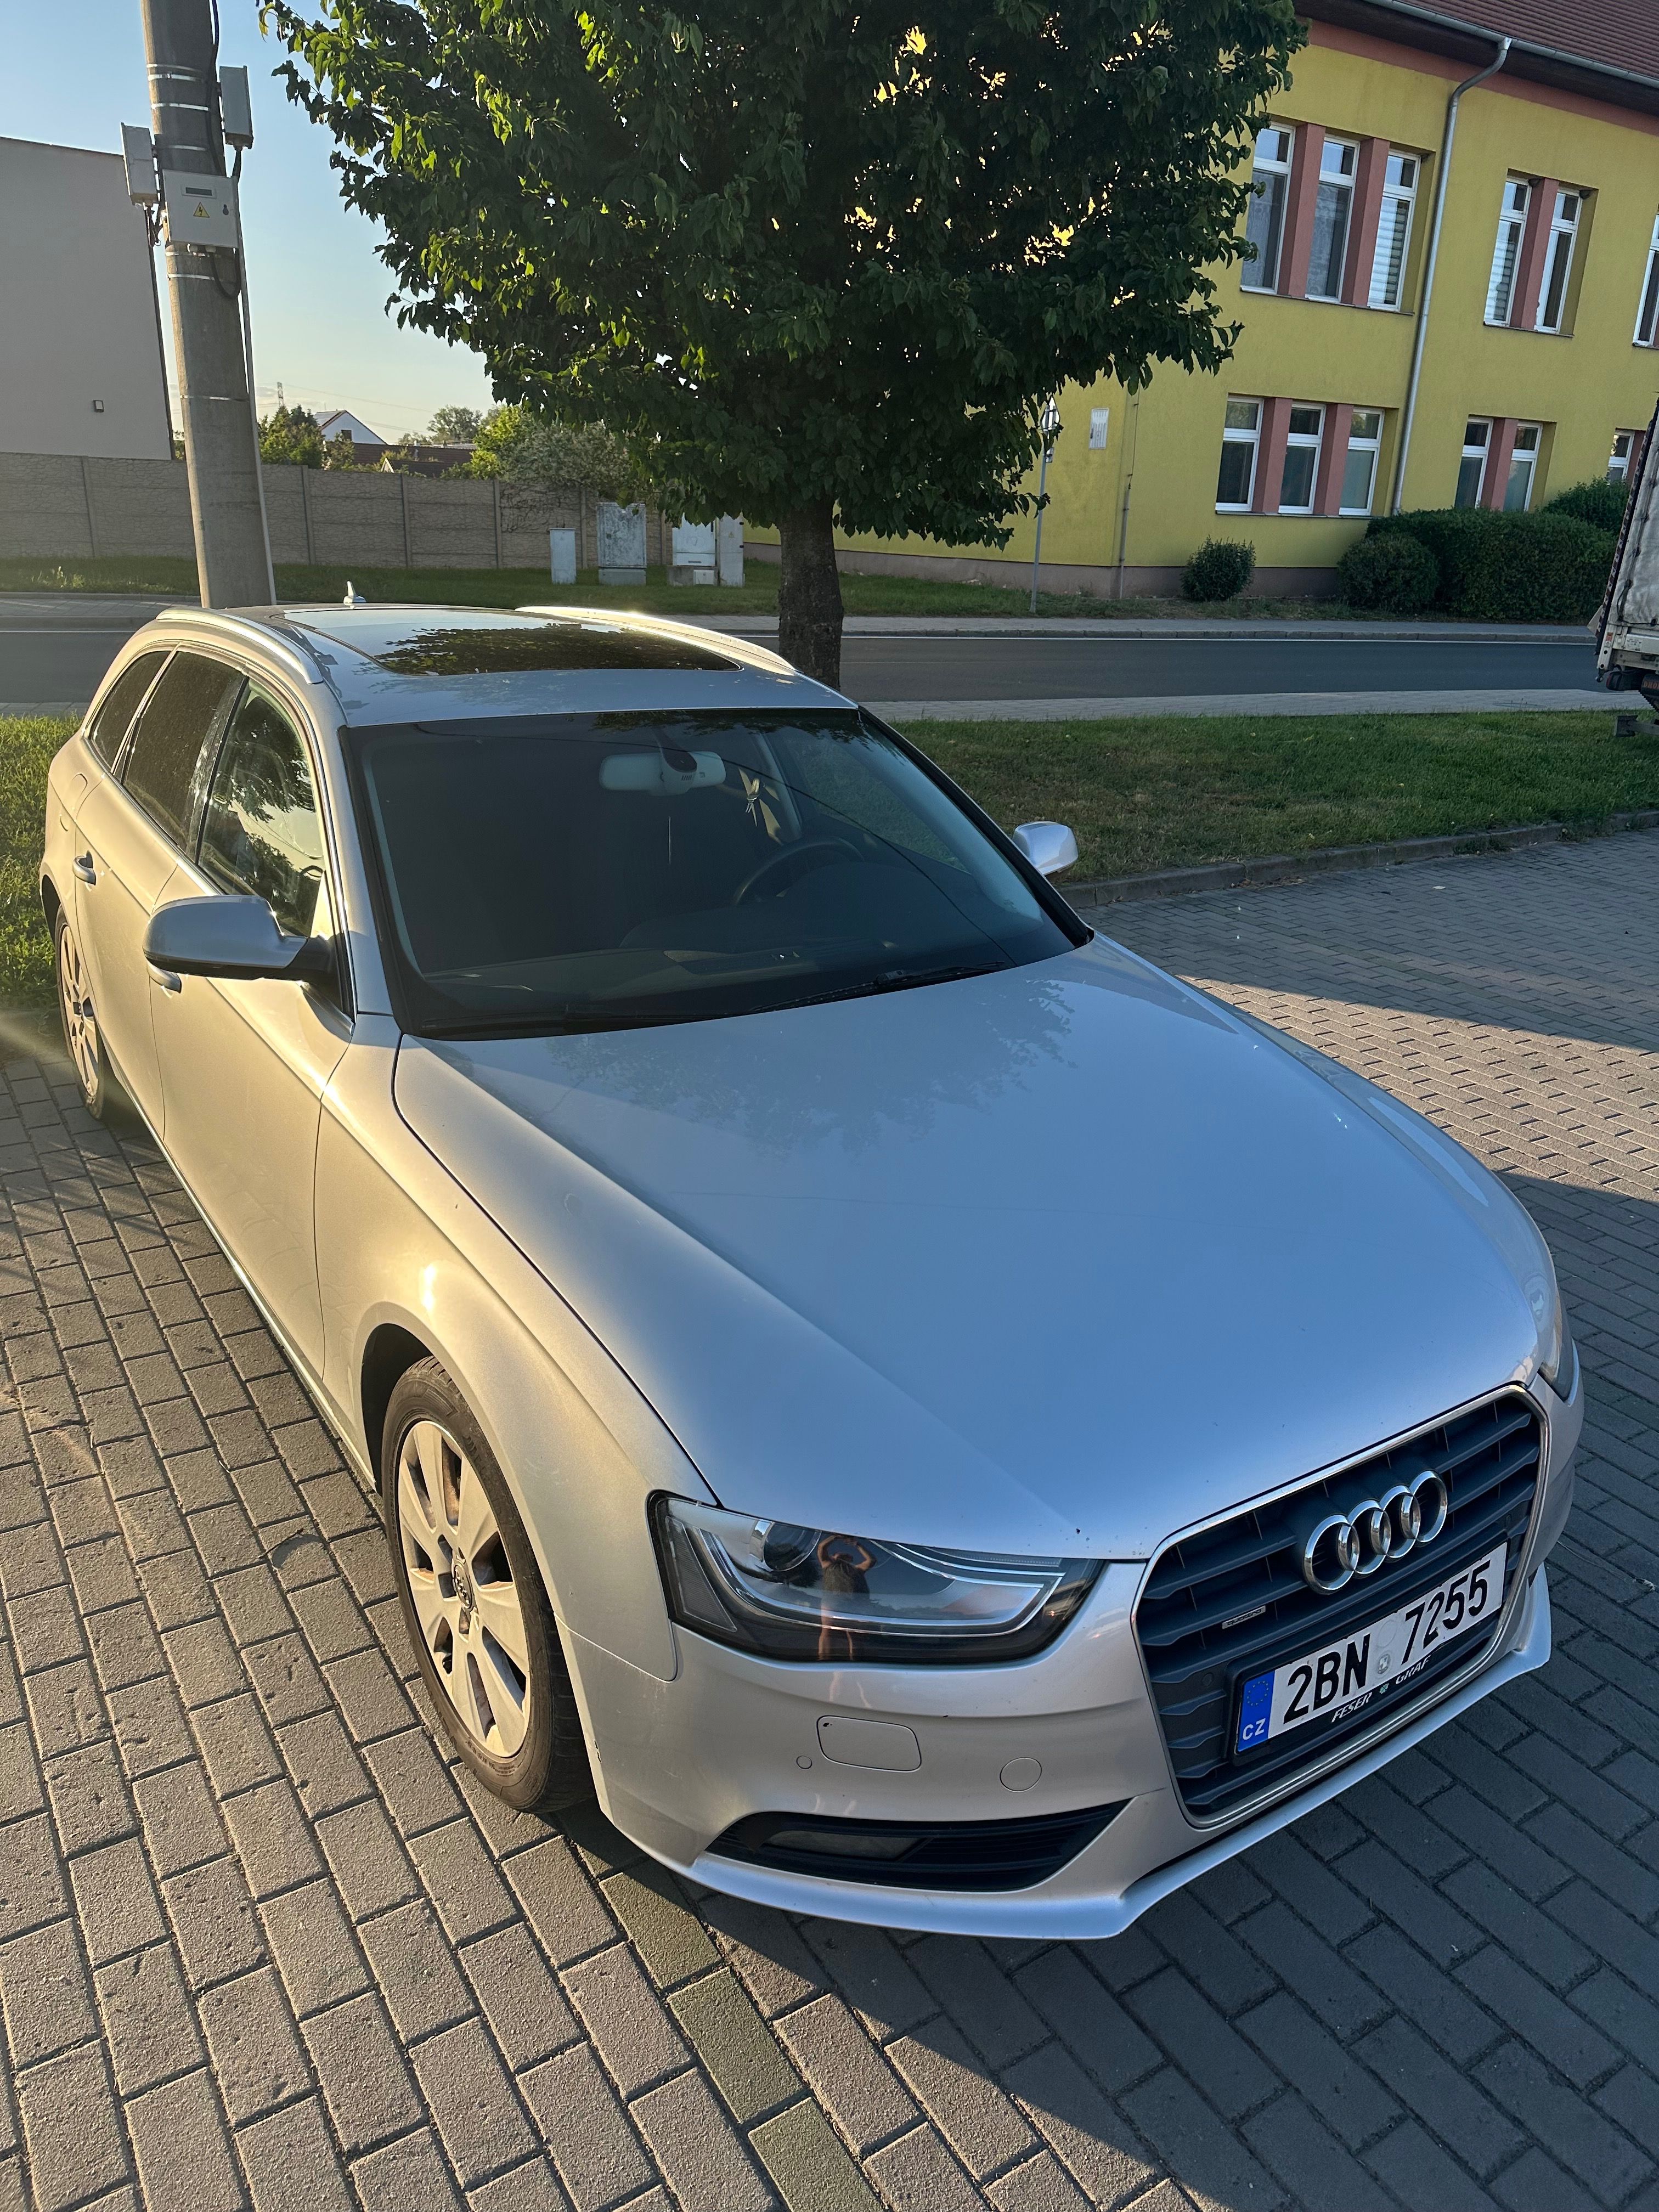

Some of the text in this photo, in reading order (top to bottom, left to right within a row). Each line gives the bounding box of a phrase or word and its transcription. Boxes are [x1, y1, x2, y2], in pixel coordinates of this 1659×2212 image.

[1227, 1609, 1262, 1626] quattro
[1283, 1559, 1491, 1724] 2BN 7255
[1331, 1655, 1431, 1723] FESER GRAF
[1242, 1718, 1266, 1740] CZ
